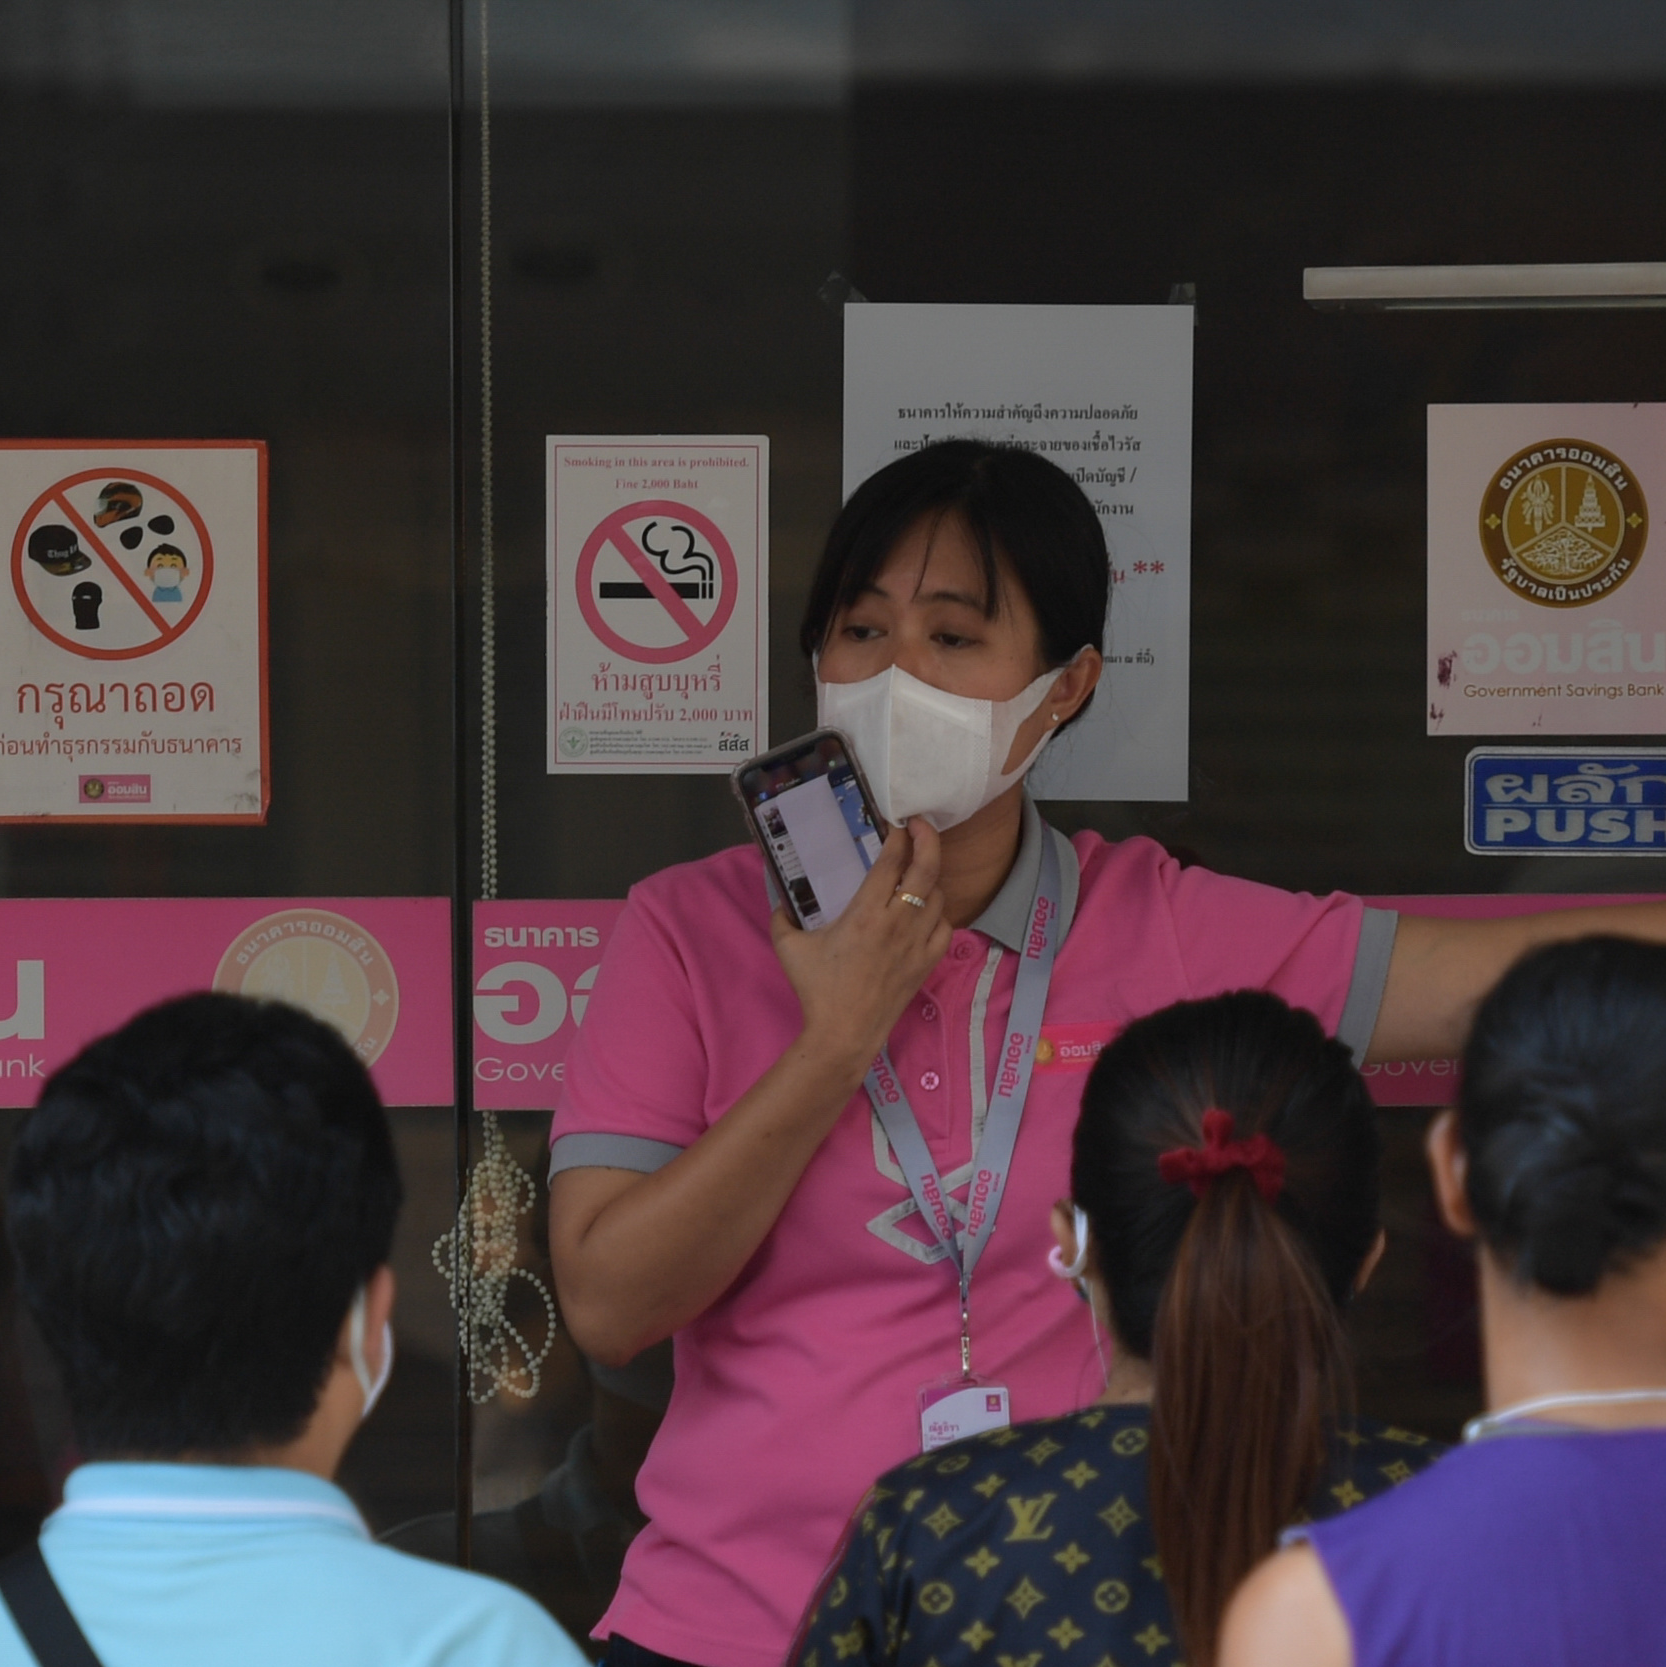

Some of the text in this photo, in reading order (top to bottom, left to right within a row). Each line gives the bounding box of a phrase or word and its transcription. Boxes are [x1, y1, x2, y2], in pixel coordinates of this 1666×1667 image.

[564, 457, 749, 469] Smoking in this area is prohibited.
[1498, 445, 1629, 492] ธนาคารออมสิน
[615, 479, 699, 491] Fine 2,000 Baht
[1499, 556, 1632, 603] รัฐบาลเป็นประกัน
[591, 654, 722, 700] ห้ามสูบบุหรี่
[1463, 683, 1664, 699] Government Savings Bank
[16, 680, 216, 730] กรุณาถอด
[558, 701, 753, 722] ฝ่าฝืนมีโทษปรับ 2,000 บาท
[236, 921, 374, 965] ธนาคารออมสิน
[484, 926, 599, 948] ธนาคาร
